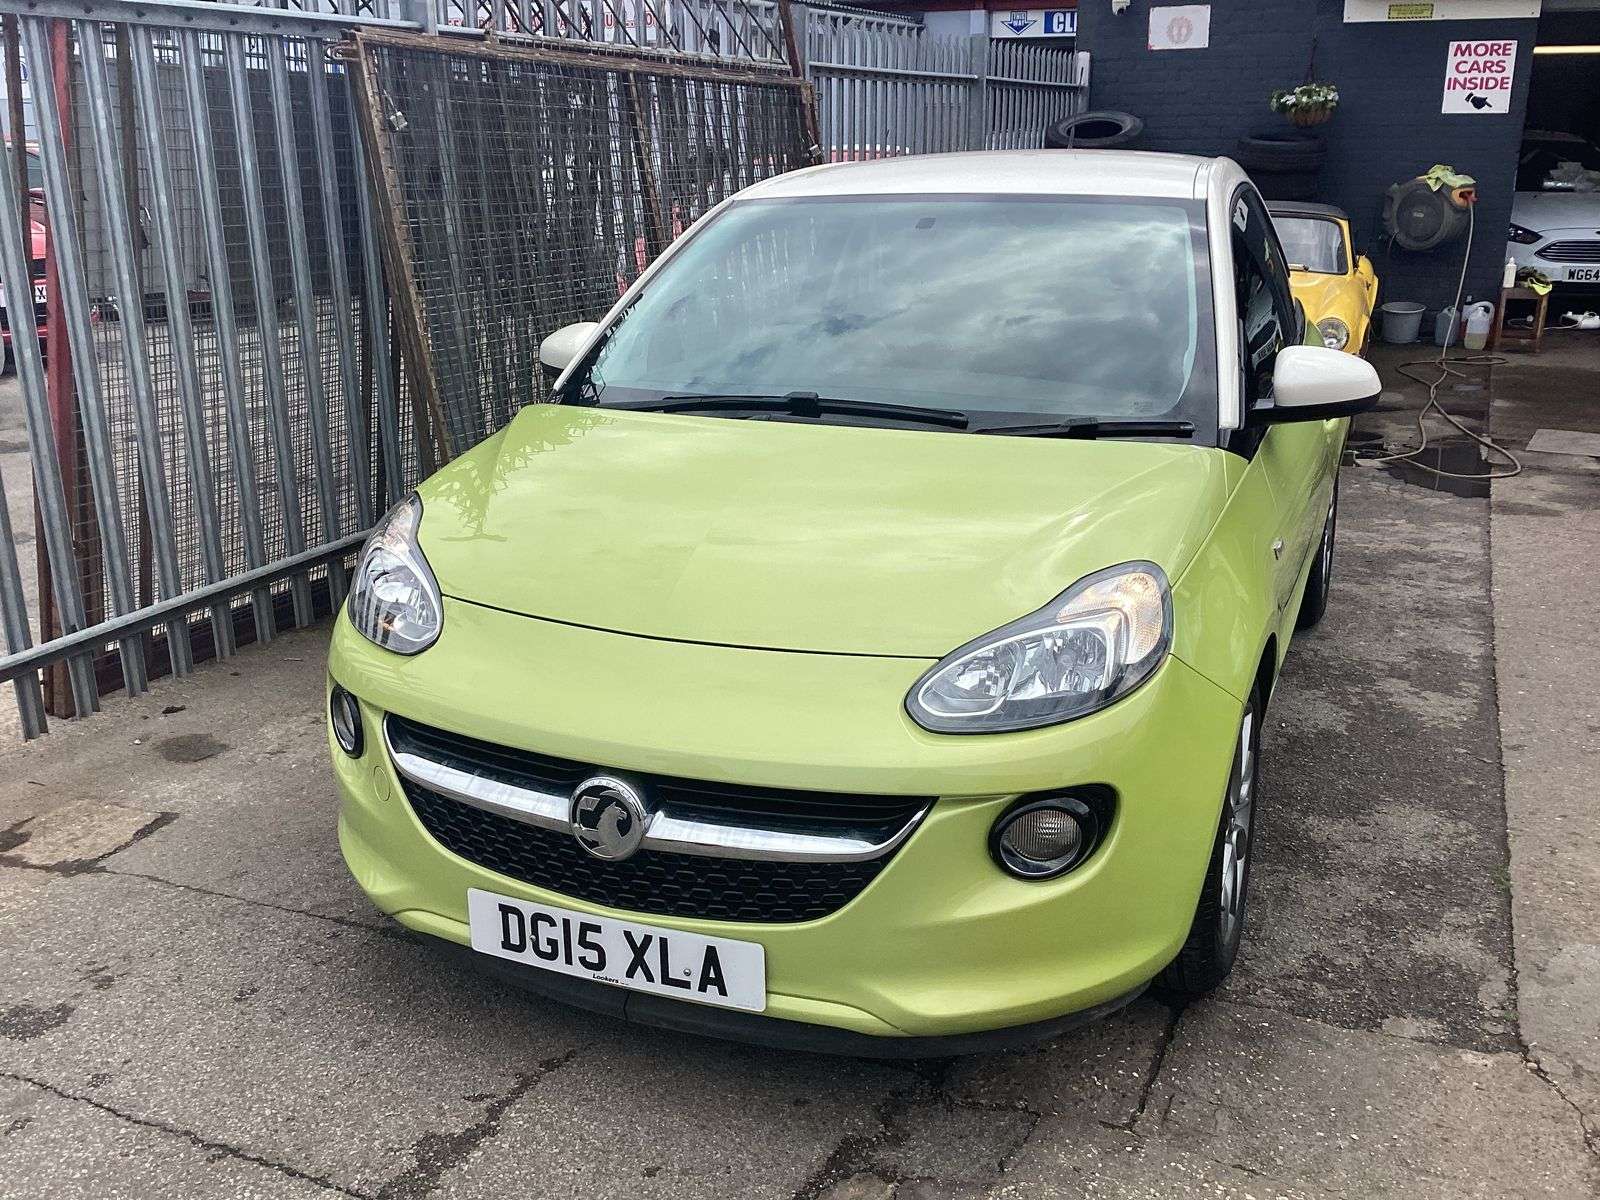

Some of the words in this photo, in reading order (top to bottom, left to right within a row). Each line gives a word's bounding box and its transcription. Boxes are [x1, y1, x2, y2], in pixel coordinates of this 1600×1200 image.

[1453, 43, 1513, 57] MORE
[1455, 60, 1507, 74] CARS
[1447, 77, 1511, 91] INSIDE
[1568, 268, 1600, 281] WG64
[498, 903, 607, 972] DG15
[623, 930, 728, 997] XLA
[592, 972, 619, 984] Lookers
